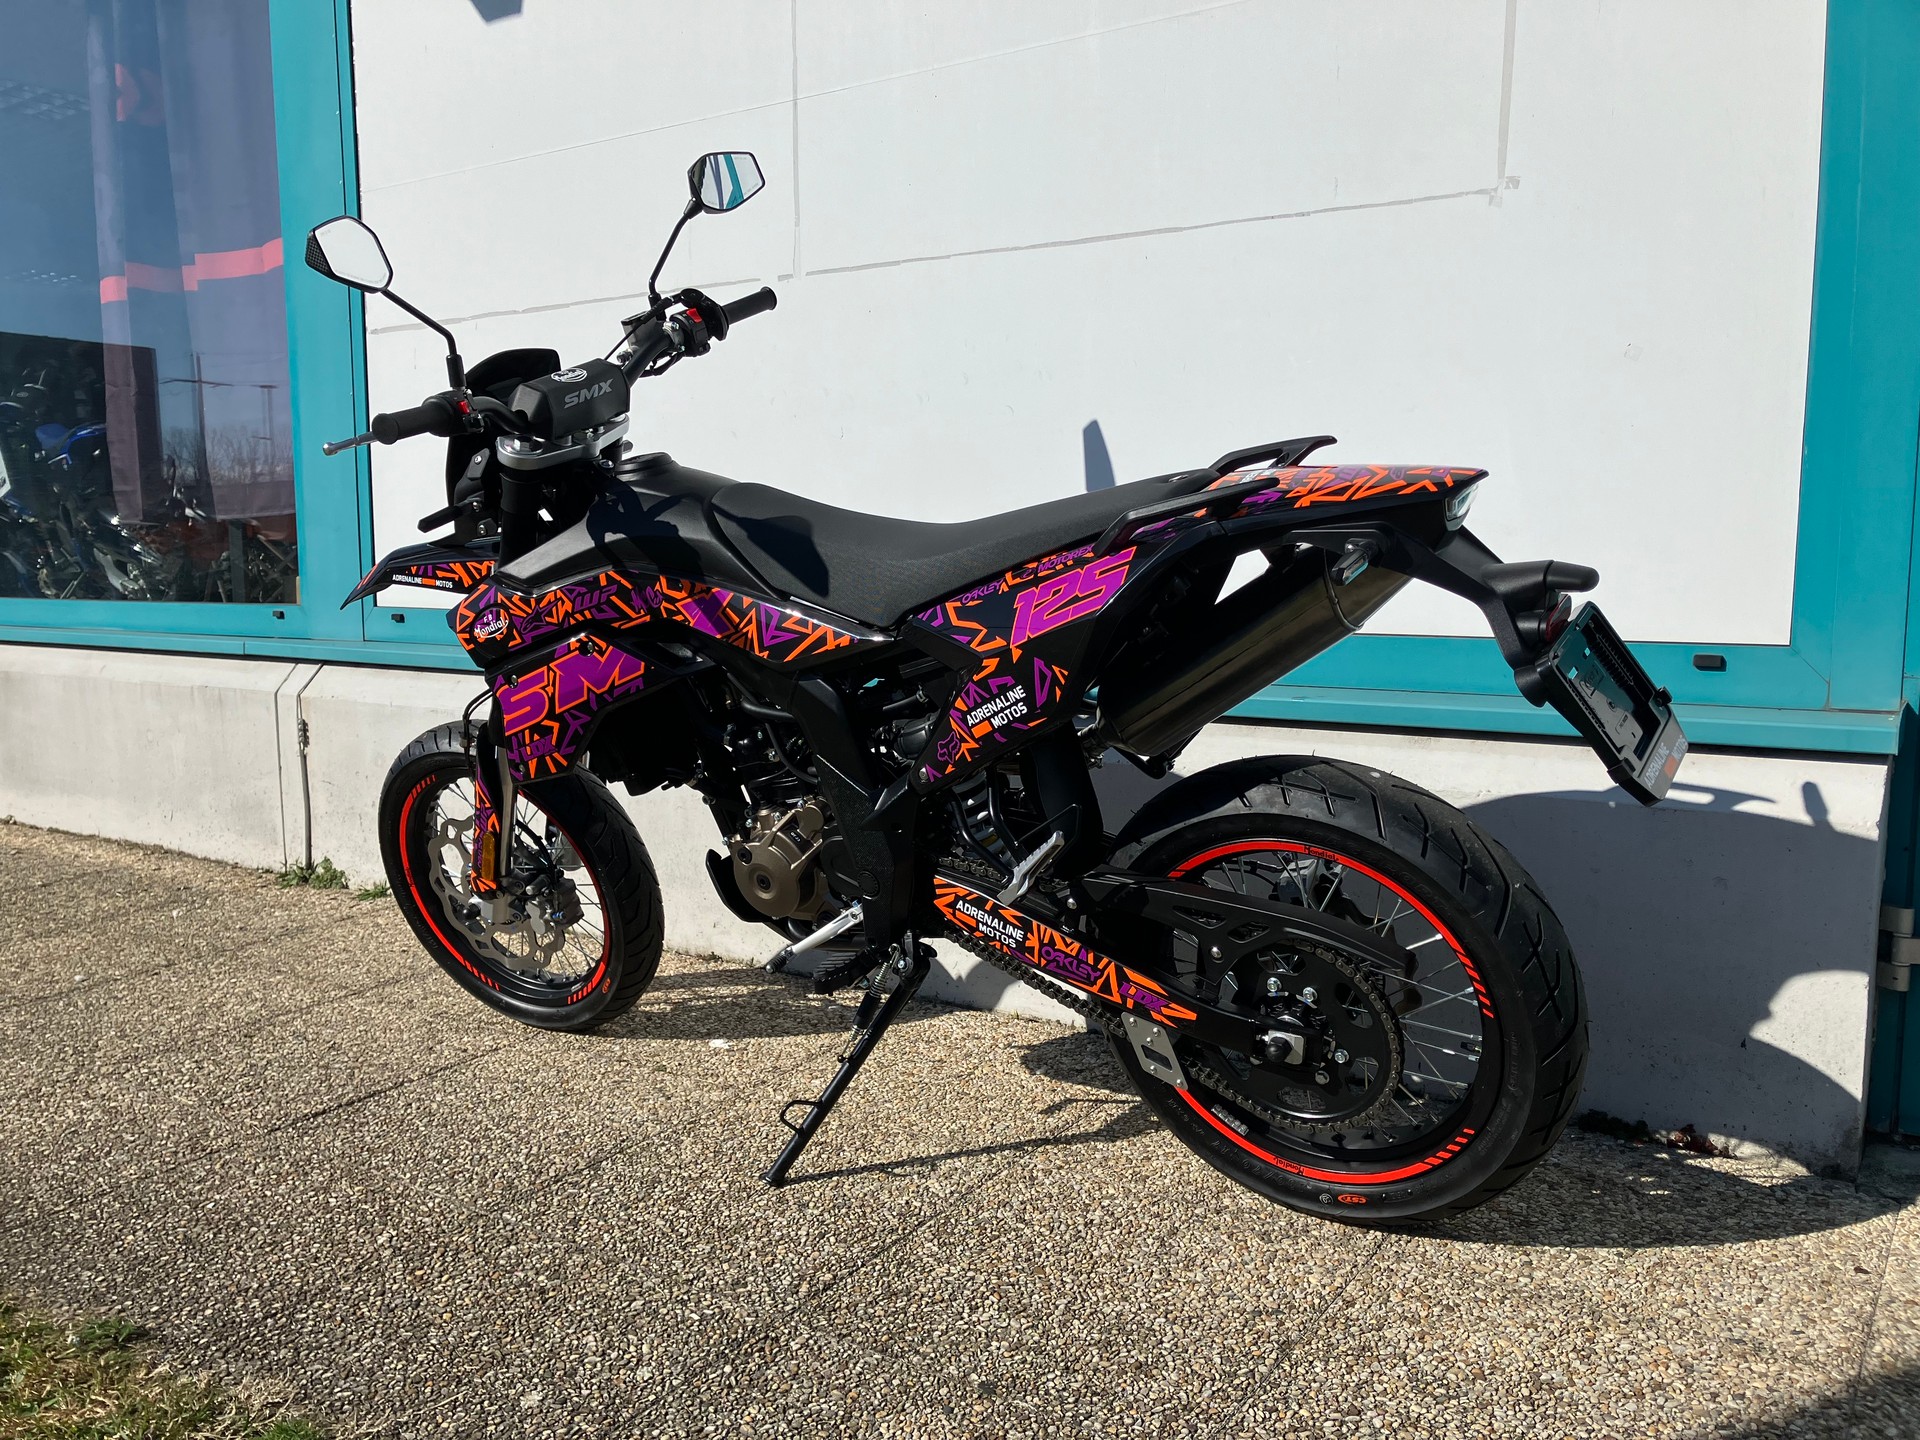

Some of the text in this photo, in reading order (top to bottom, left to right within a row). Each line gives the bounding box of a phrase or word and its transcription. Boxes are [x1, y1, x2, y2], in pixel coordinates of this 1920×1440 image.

[564, 378, 613, 409] SMX
[392, 574, 453, 588] ADRENALINE MOTOS
[962, 544, 1094, 606] OAKLEY MOTOREX
[1010, 546, 1137, 648] 125
[474, 617, 508, 638] Mondial
[496, 645, 645, 736] SM
[966, 685, 1027, 727] ADRENALINE
[990, 702, 1028, 729] MOTOS
[1643, 742, 1670, 788] ADRENALINE
[955, 899, 1025, 942] ADRENALINE
[978, 922, 1017, 948] MOTOS
[1041, 946, 1101, 982] OAKLEY
[1273, 1156, 1305, 1176] Mondial
